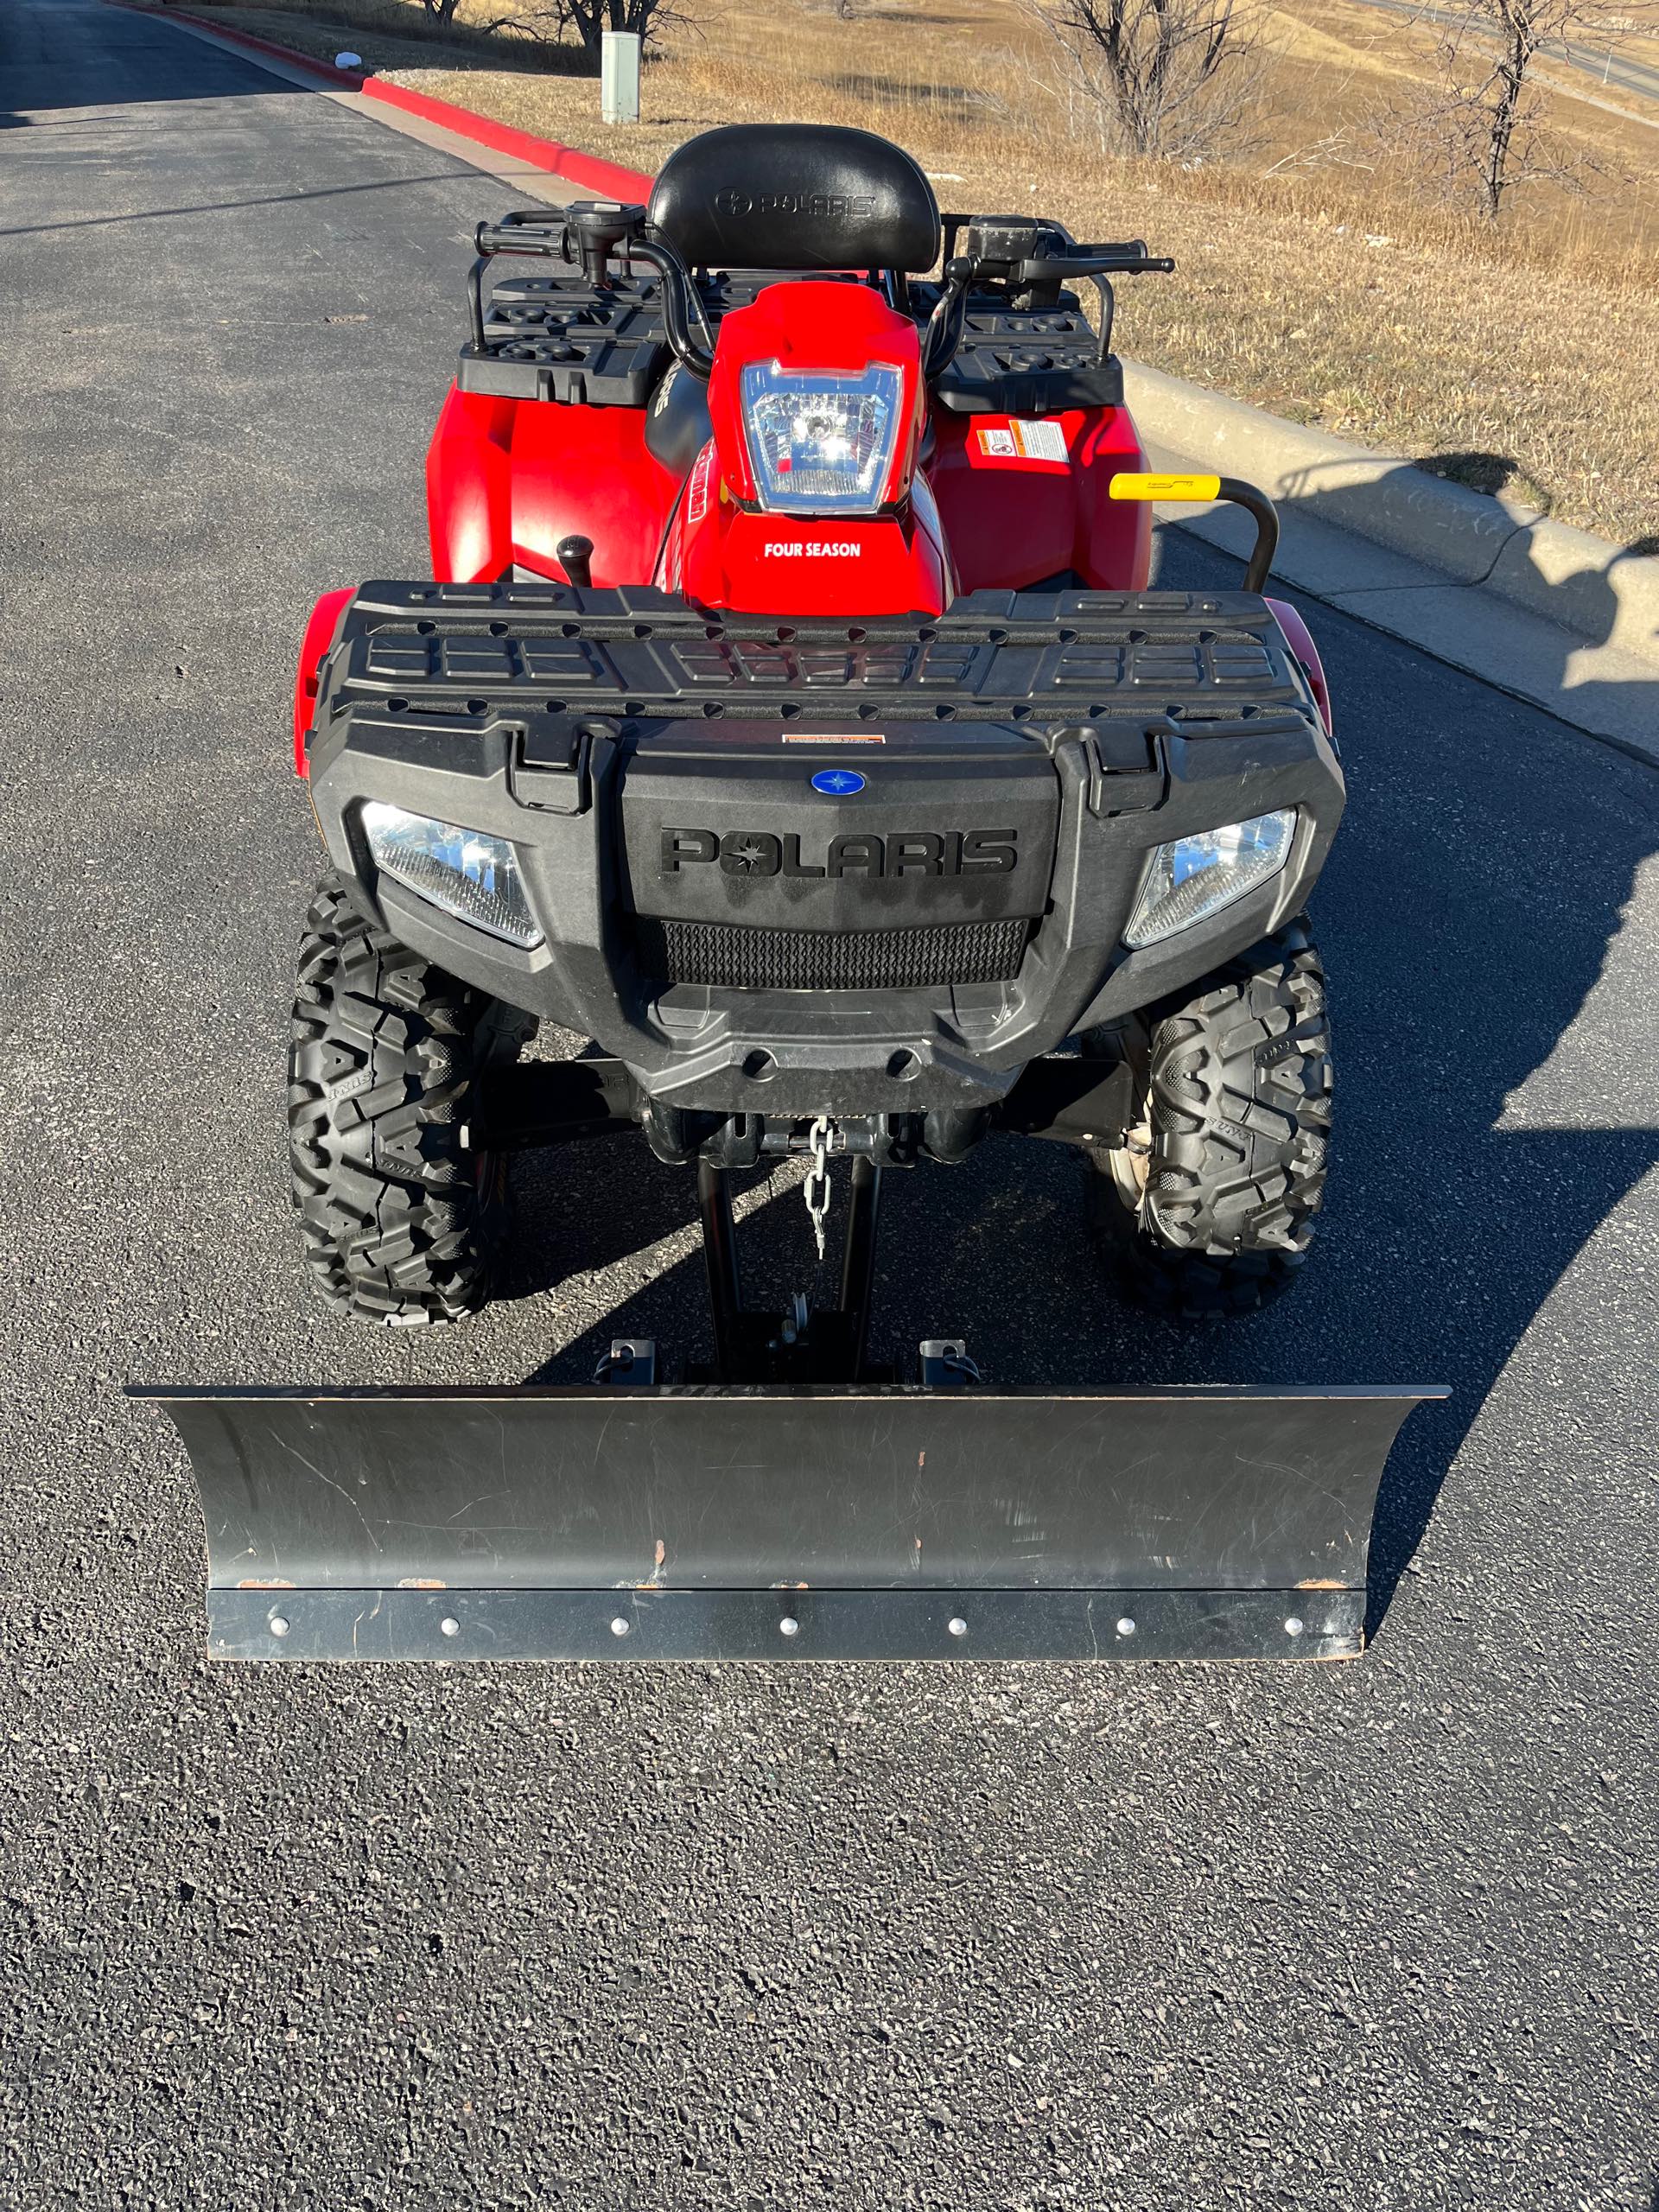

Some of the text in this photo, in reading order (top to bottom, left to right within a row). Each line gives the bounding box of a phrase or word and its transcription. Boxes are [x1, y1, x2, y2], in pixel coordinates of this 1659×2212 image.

[760, 194, 873, 216] POLARIS
[764, 542, 861, 558] FOUR SEASON
[661, 827, 1018, 879] POLARIS
